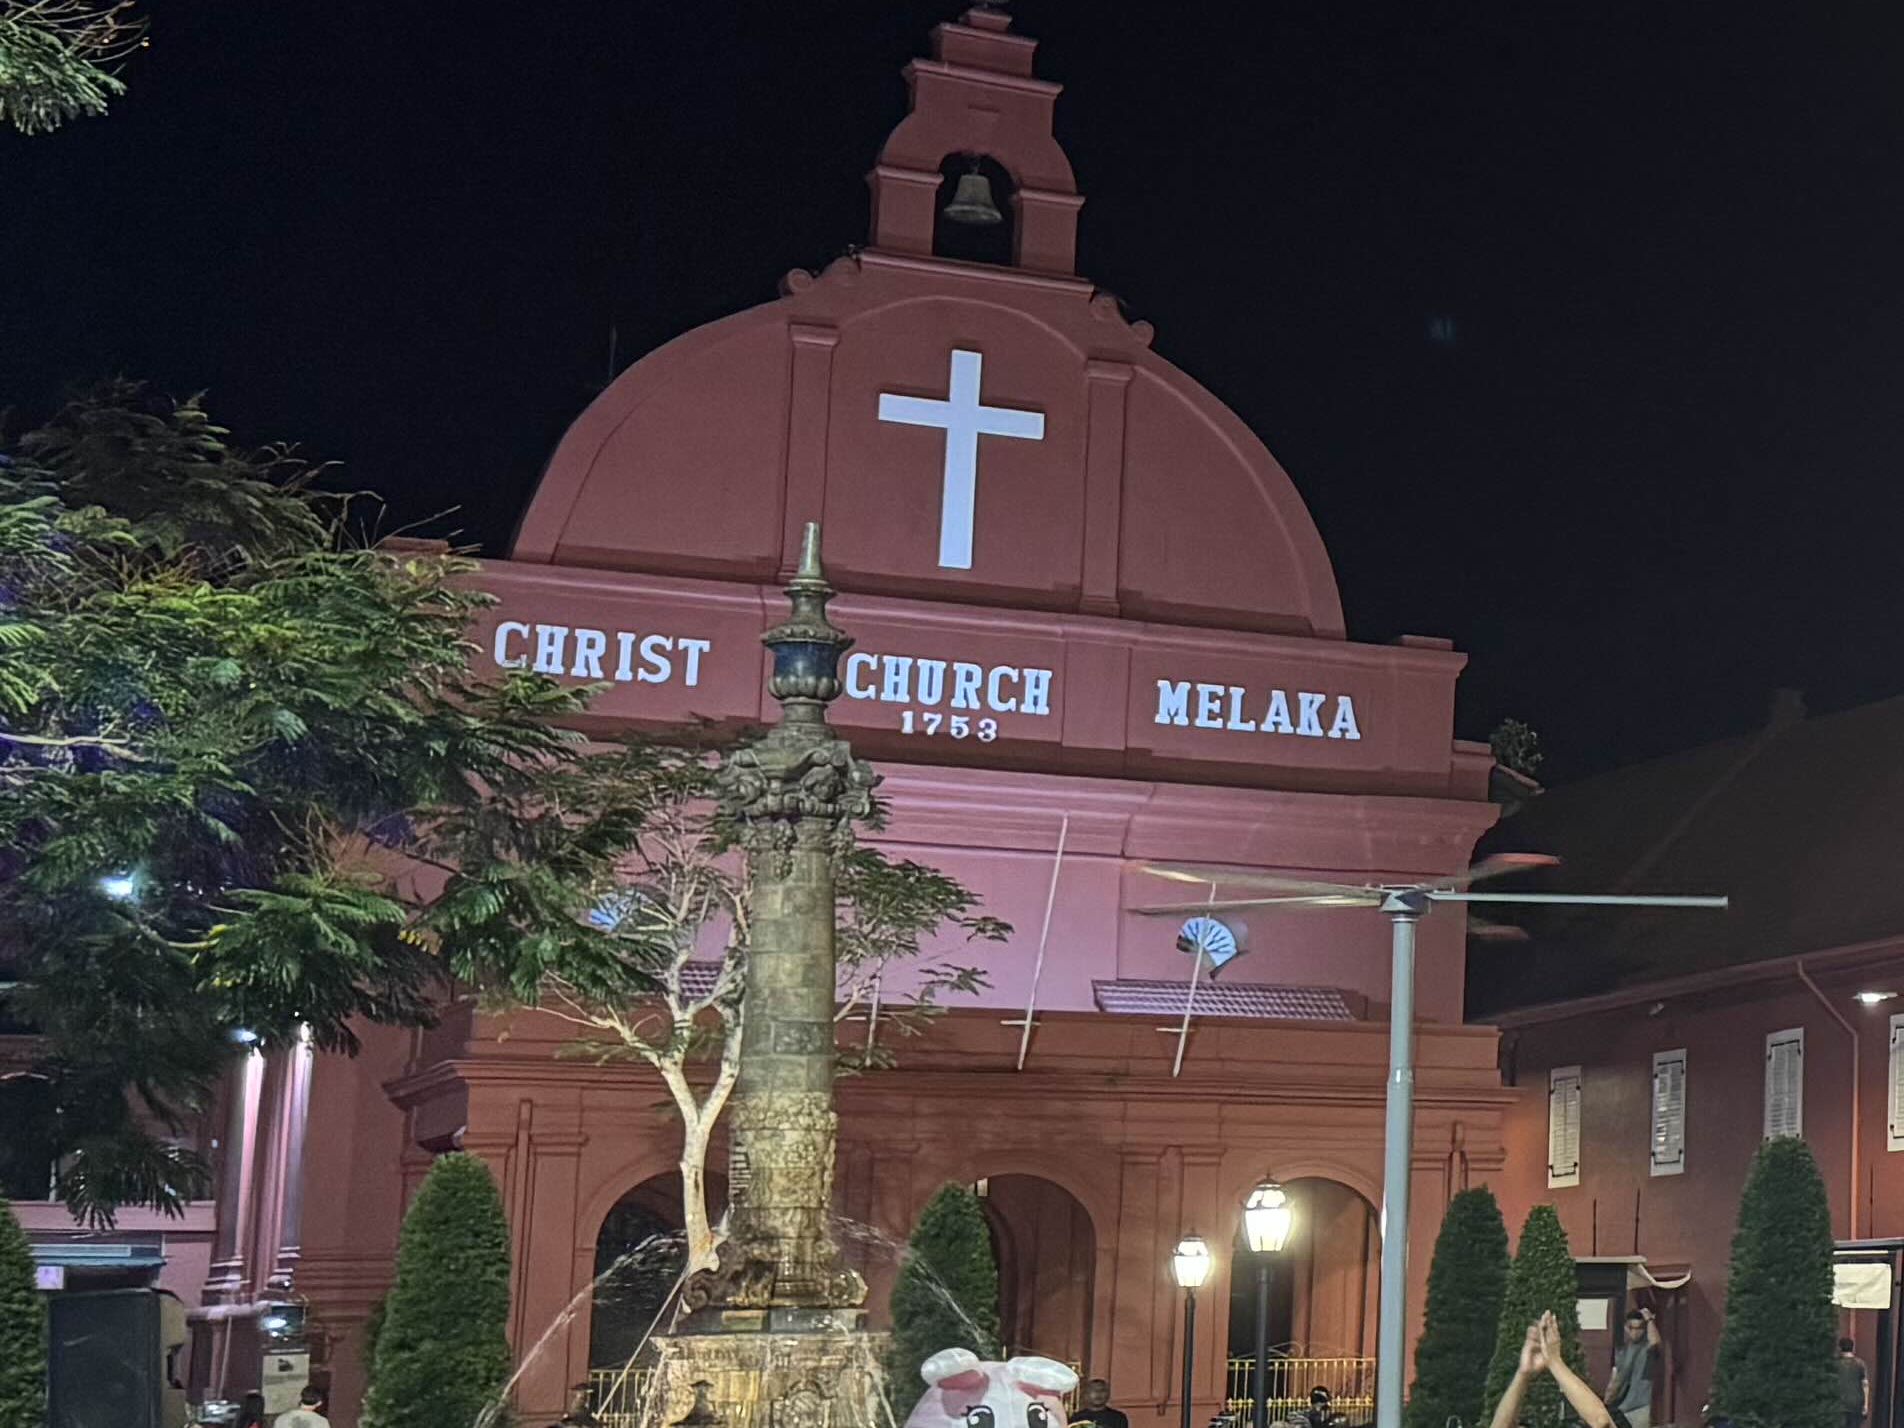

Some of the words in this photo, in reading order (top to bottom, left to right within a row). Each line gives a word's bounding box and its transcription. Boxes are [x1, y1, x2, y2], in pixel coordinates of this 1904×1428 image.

[494, 620, 711, 686] CHRIST
[845, 652, 1053, 715] CHURCH
[1154, 679, 1361, 740] MELAKA
[901, 710, 998, 742] 1753
